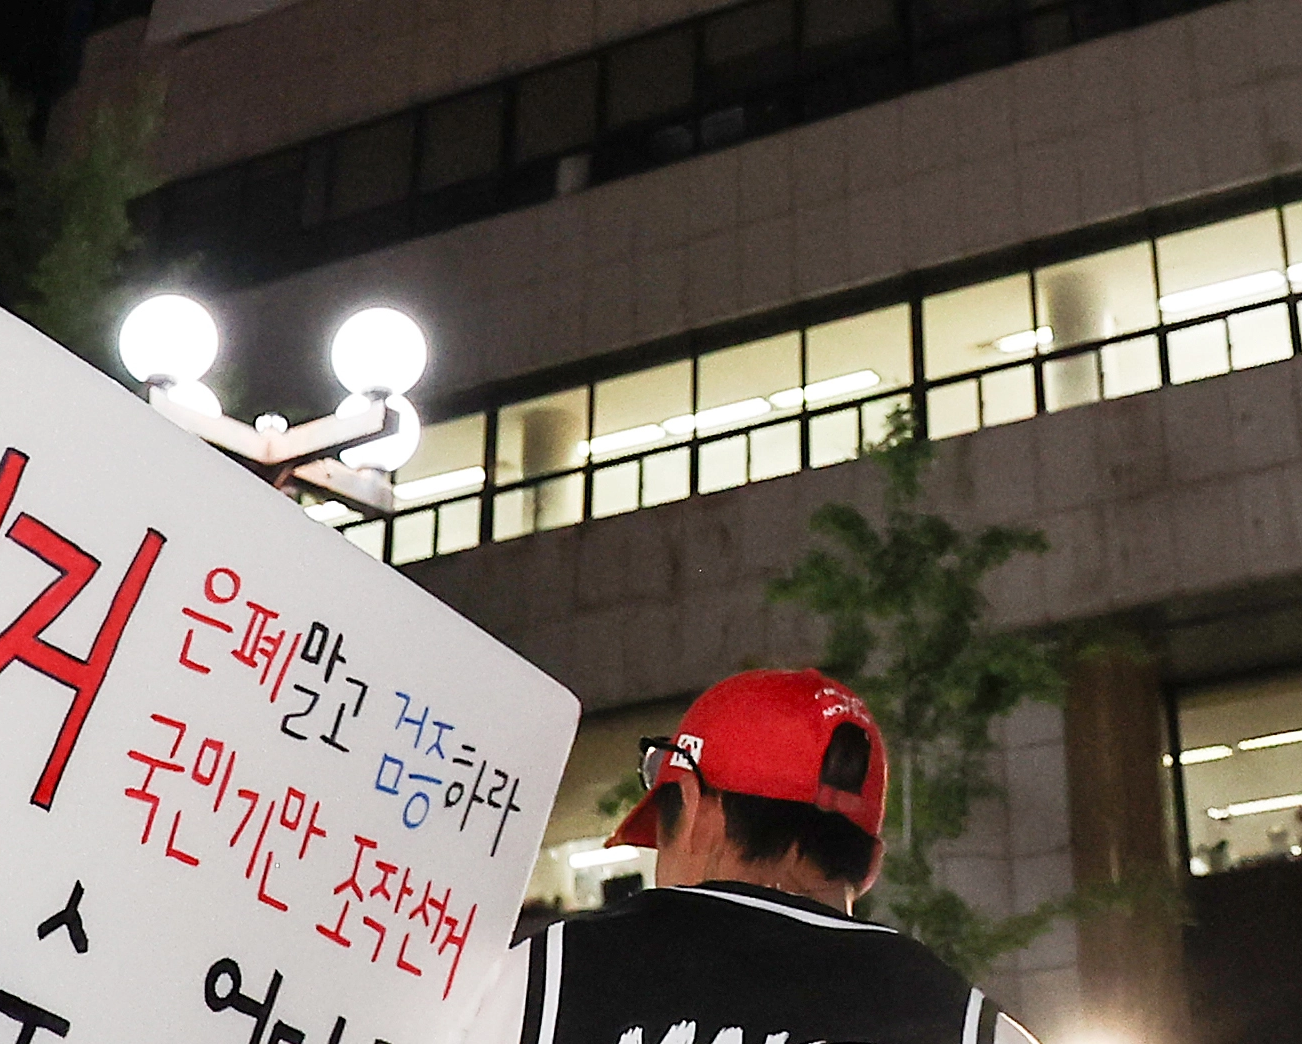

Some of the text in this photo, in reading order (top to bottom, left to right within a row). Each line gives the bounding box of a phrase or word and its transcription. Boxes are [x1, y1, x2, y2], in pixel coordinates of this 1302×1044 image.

[125, 714, 477, 1000] 국민기만 조작선거
[375, 692, 520, 857] 검증하라
